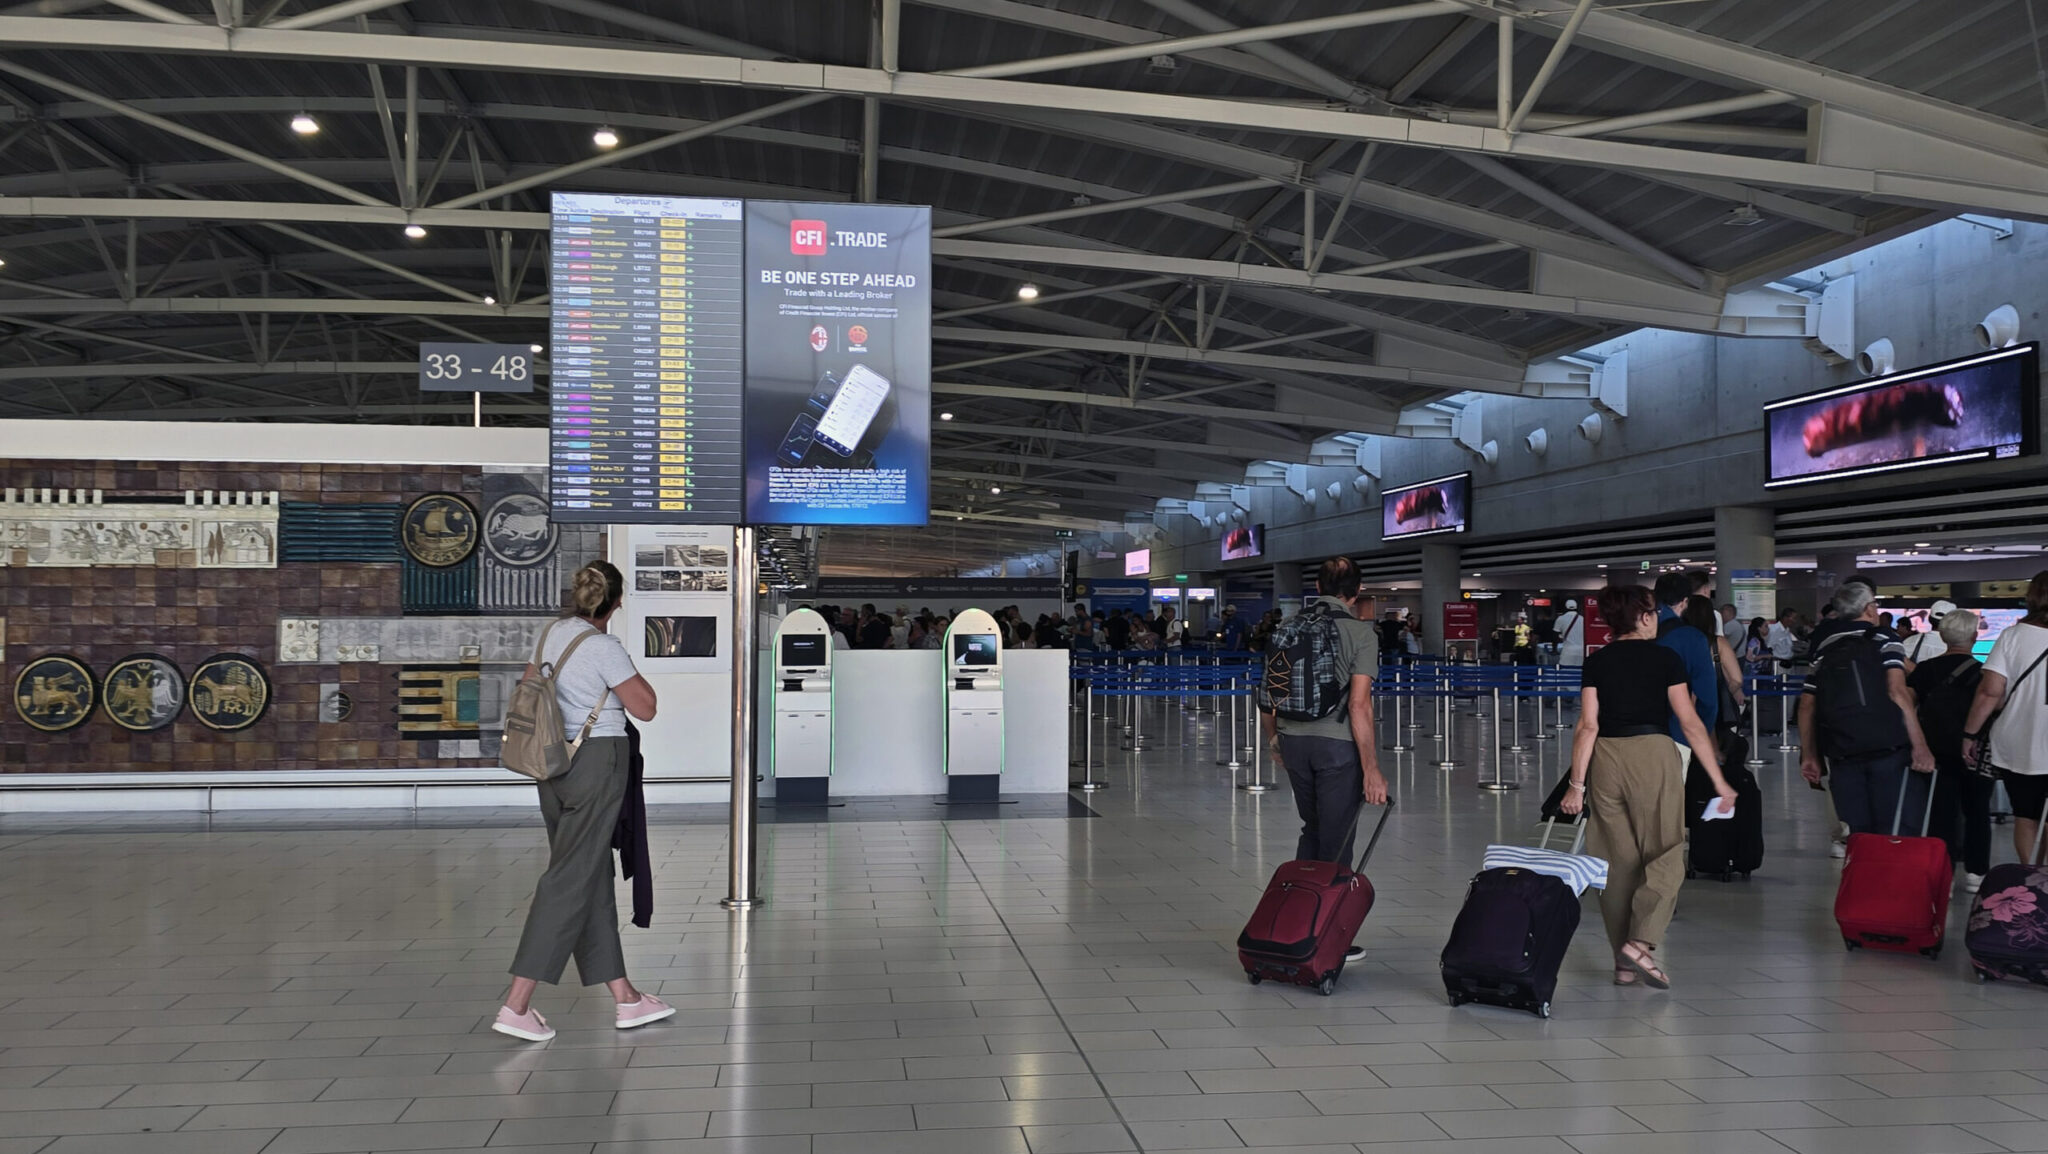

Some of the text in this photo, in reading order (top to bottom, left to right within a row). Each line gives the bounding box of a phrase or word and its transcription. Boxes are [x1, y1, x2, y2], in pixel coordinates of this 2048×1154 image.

[614, 197, 661, 207] Departures
[796, 230, 888, 248] CFI .TRADE
[761, 270, 916, 287] BE ONE STEP AHEAD
[784, 288, 807, 297] Trade
[809, 289, 826, 298] with
[834, 290, 865, 300] Leading
[866, 291, 893, 299] Broker
[426, 353, 462, 380] 33
[490, 355, 527, 381] 48
